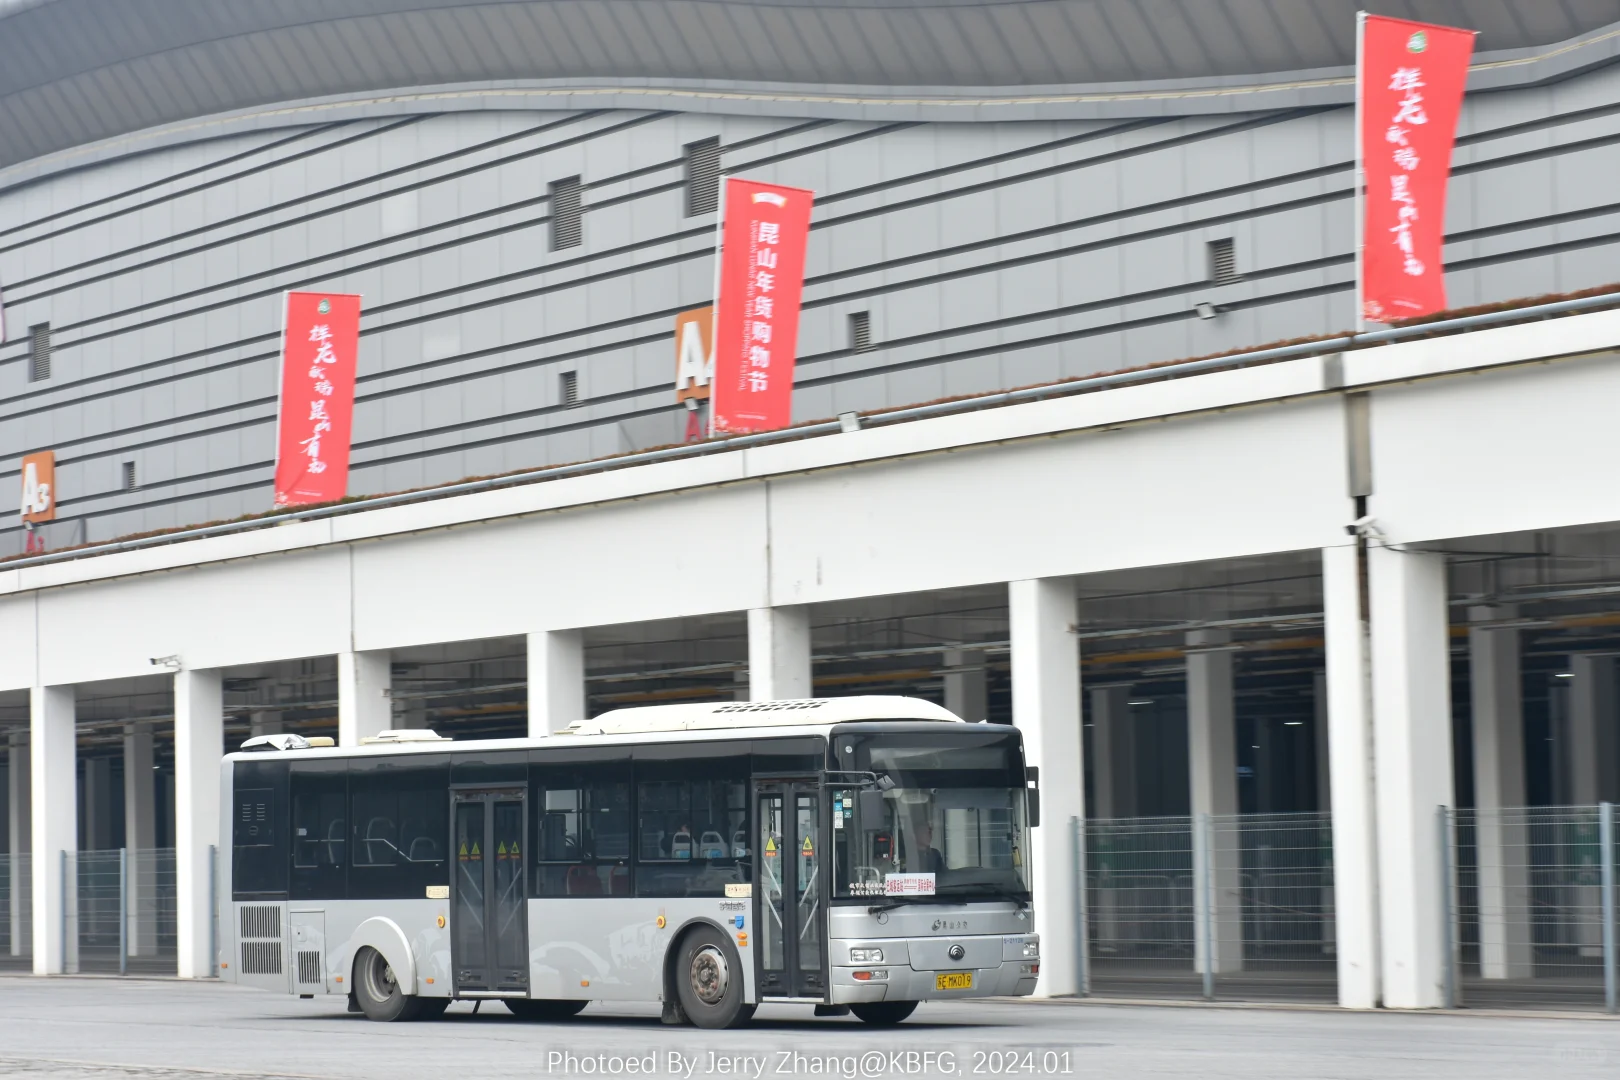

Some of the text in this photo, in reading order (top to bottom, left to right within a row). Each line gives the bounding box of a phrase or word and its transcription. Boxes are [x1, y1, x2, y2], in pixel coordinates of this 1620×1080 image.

[750, 219, 758, 252] KUNSHAN
[746, 280, 755, 297] NEW
[744, 300, 753, 317] YEAR
[748, 222, 780, 392] 昆山年货购物节
[20, 462, 51, 515] A3
